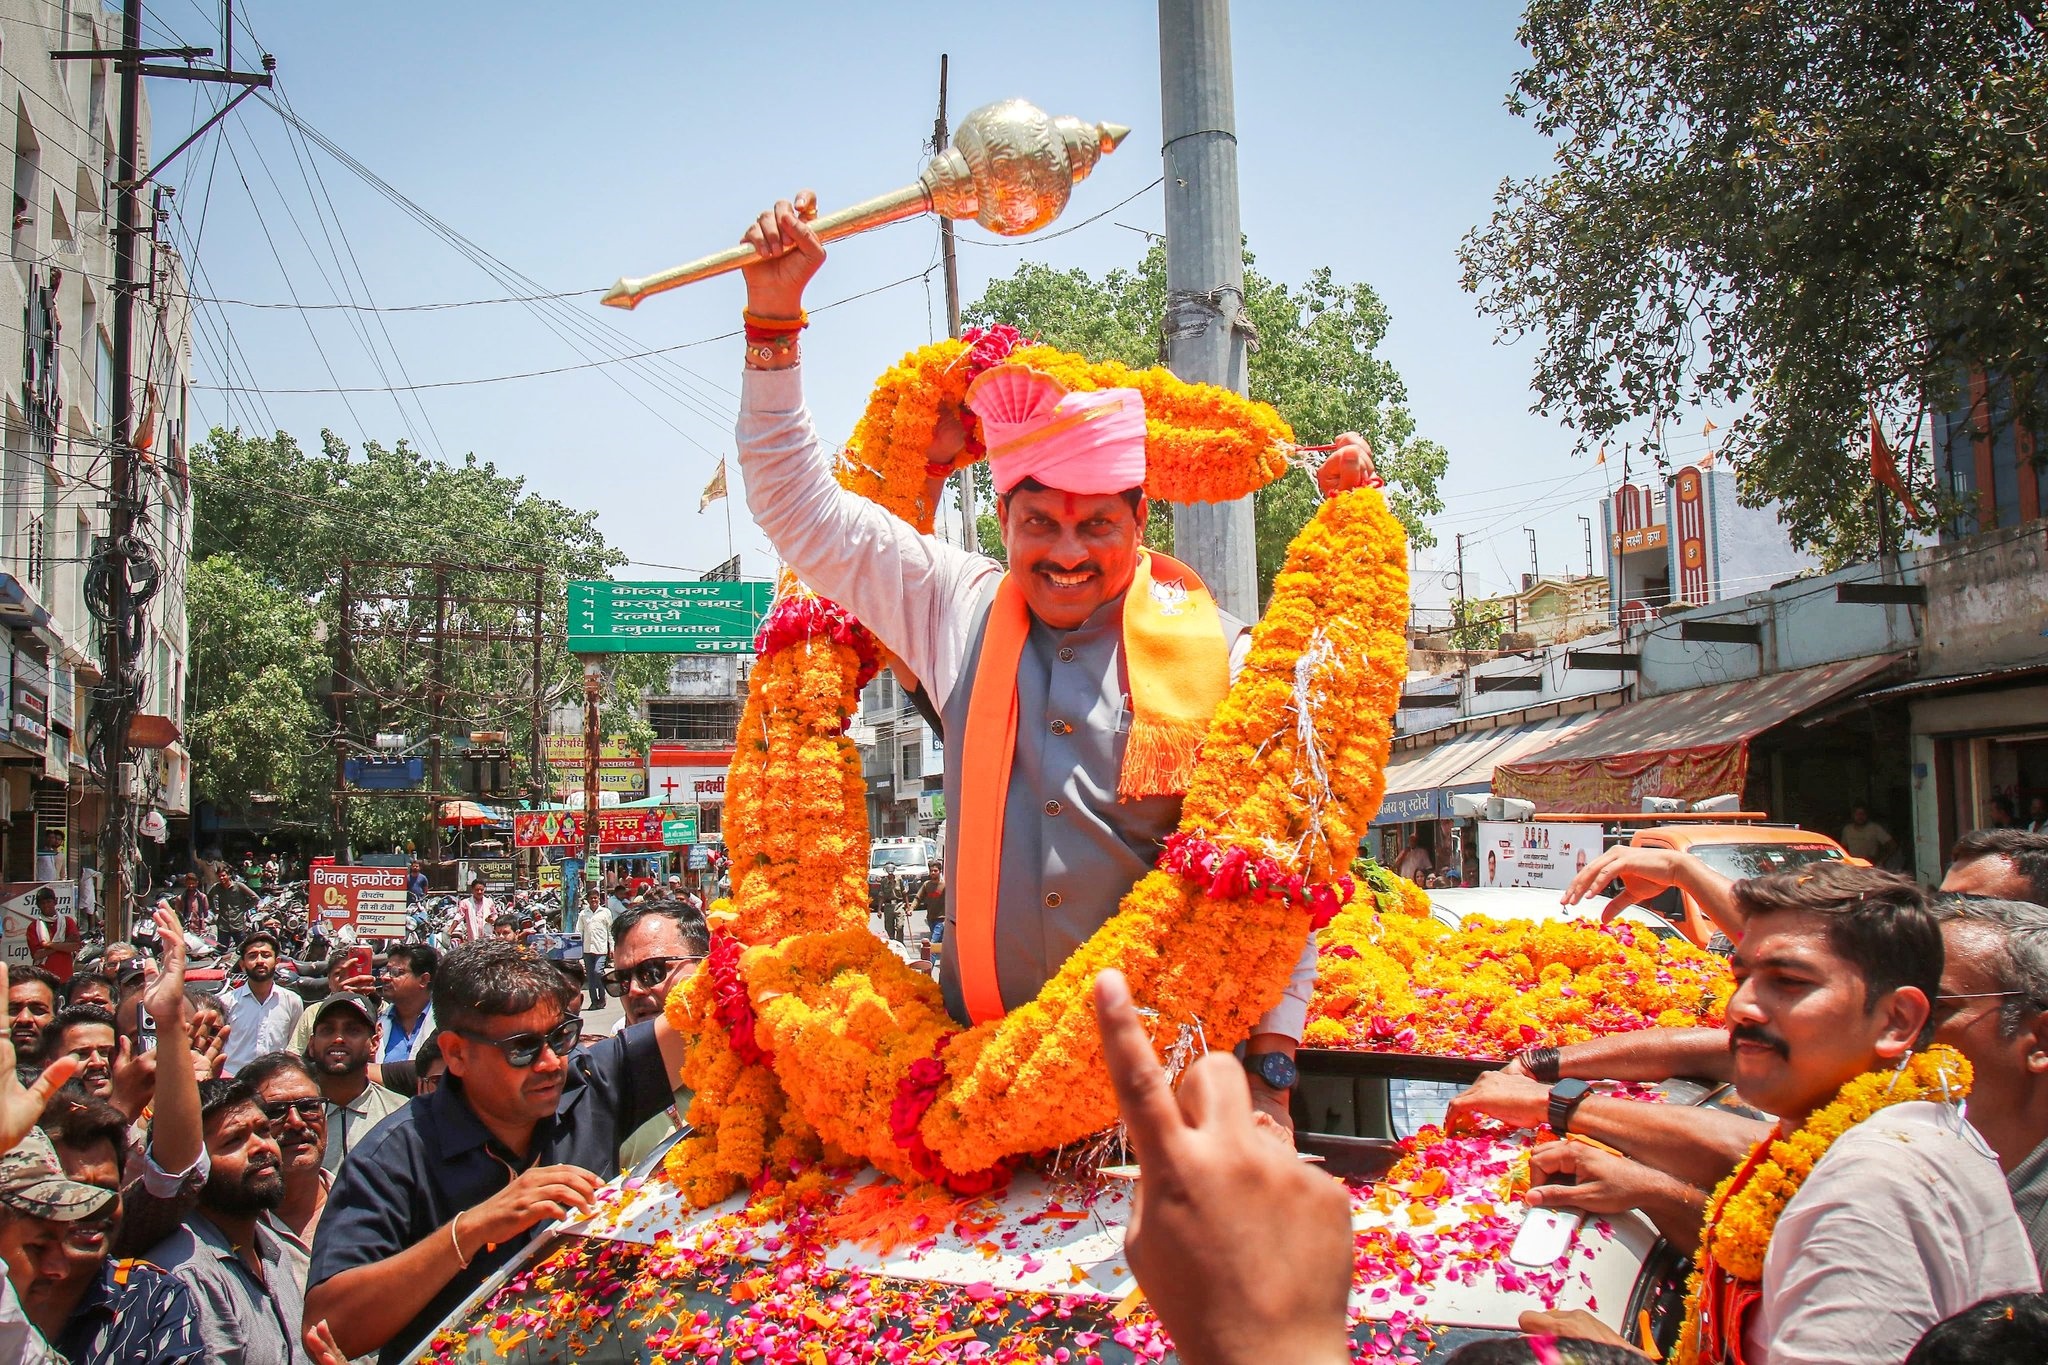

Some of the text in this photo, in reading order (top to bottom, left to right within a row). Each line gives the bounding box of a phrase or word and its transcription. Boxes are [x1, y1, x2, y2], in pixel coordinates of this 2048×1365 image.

[1626, 531, 1643, 548] लक्ष्मी
[1647, 530, 1661, 546] कृपा
[697, 599, 743, 608] नगर
[611, 609, 682, 623] रत्नपुरी
[611, 625, 720, 636] हनुमानताल
[1399, 800, 1410, 817] शू
[1408, 792, 1431, 812] स्टोर्स
[614, 818, 639, 830] रस
[314, 869, 405, 888] शिवम् इन्फोटेक
[323, 886, 348, 906] 0%
[360, 902, 369, 911] सी
[370, 902, 379, 911] सी
